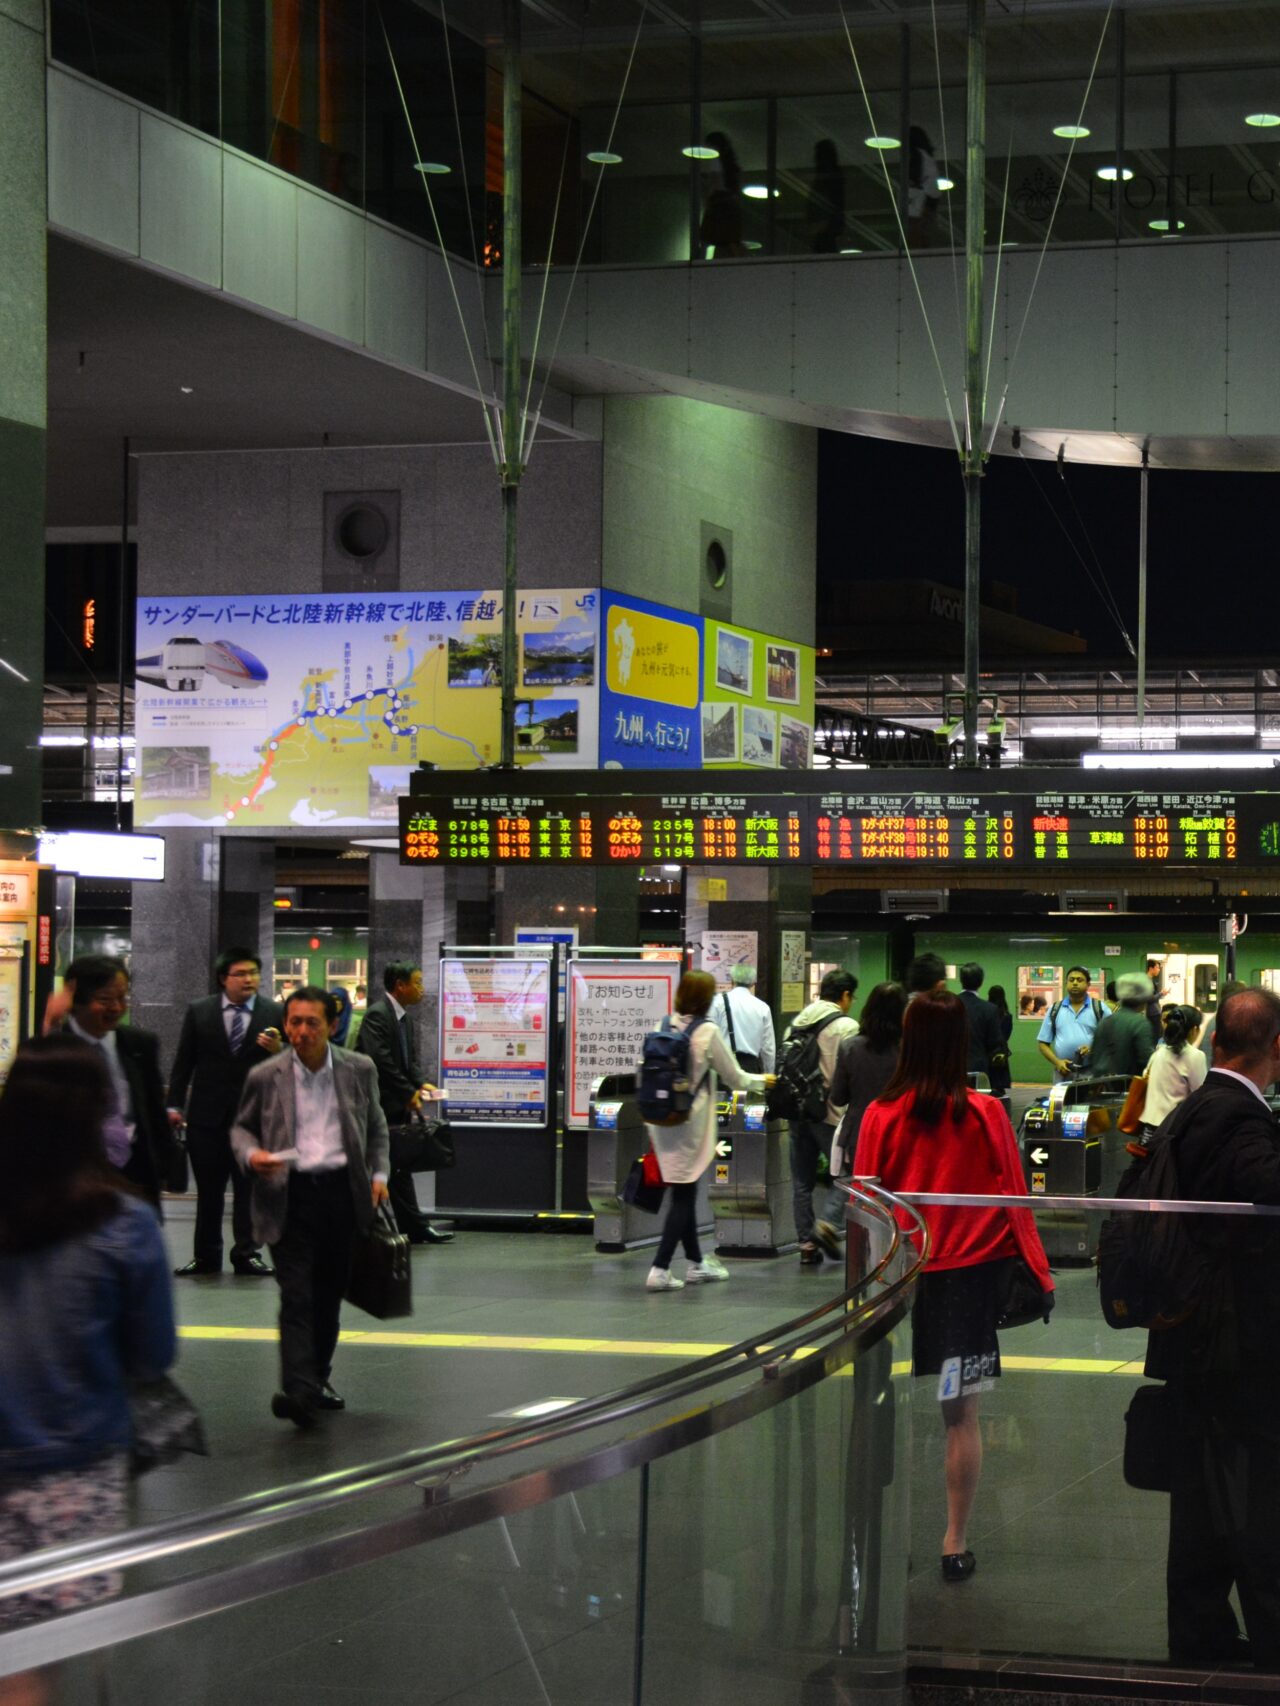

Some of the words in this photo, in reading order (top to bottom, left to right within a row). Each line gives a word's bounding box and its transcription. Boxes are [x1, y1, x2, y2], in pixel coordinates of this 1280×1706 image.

[1088, 174, 1222, 211] HOTEL
[575, 595, 597, 607] JR
[614, 710, 690, 751] 九州へ行こう!
[409, 820, 436, 830] こだま
[450, 820, 488, 830] 678号
[540, 820, 570, 830] 東京
[580, 819, 591, 830] 12
[609, 818, 642, 831] のぞみ
[654, 819, 693, 830] 235号
[706, 819, 736, 830] 18:00
[746, 819, 778, 830] 新大阪
[788, 819, 799, 830] 13
[818, 818, 851, 831] 特急
[915, 818, 948, 830] 18:09
[965, 819, 997, 830] 金沢
[1034, 817, 1068, 830] 新快速
[1135, 818, 1167, 829] 18:01
[1227, 818, 1235, 829] 2
[407, 832, 438, 845] のぞみ
[451, 833, 488, 844] 248号
[498, 832, 530, 844] 18:05
[540, 833, 570, 844] 東京
[580, 832, 591, 844] 12
[609, 832, 642, 845] のぞみ
[655, 833, 693, 844] 117号
[706, 832, 736, 843] 18:10
[747, 833, 778, 844] 広島
[788, 832, 799, 843] 14
[818, 831, 852, 844] 特急
[915, 832, 948, 843] 18:40
[965, 832, 998, 844] 金沢
[1035, 832, 1067, 844] 普通
[1090, 832, 1123, 844] 草津線
[1135, 832, 1168, 843] 18:04
[407, 846, 439, 857] のぞみ
[451, 847, 489, 857] 398号
[499, 846, 530, 857] 18:12
[541, 847, 571, 857] 東京
[580, 846, 592, 857] 12
[610, 845, 641, 857] ひかり
[654, 846, 694, 857] 519号
[706, 846, 736, 857] 18:13
[746, 846, 778, 857] 新大阪
[789, 846, 799, 857] 13
[818, 845, 852, 858] 特急
[915, 846, 948, 857] 19:10
[965, 846, 998, 857] 金沢
[1035, 846, 1068, 858] 普通
[1135, 846, 1168, 857] 18:07
[1186, 846, 1219, 858] 米原
[1227, 846, 1235, 857] 2
[588, 985, 654, 999] 『お知らせ』
[578, 1008, 644, 1017] 改札・ホームでの
